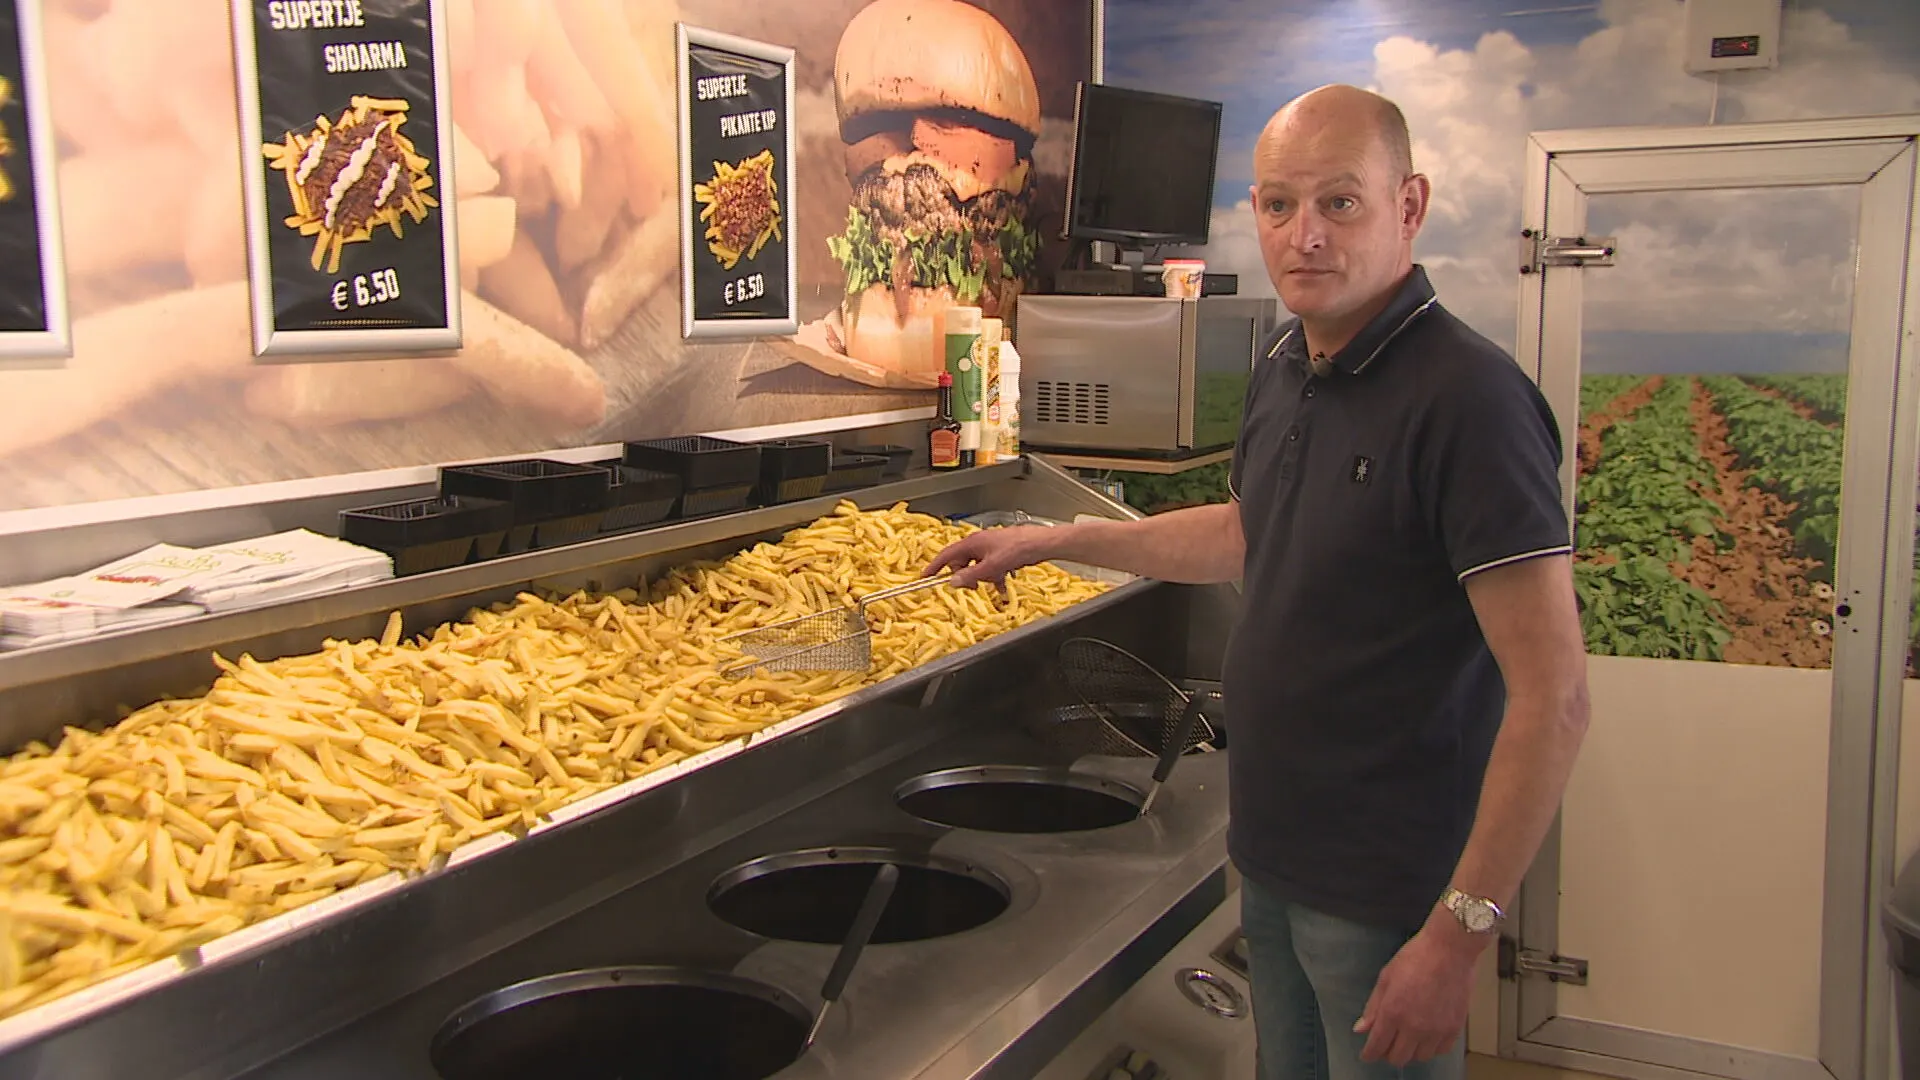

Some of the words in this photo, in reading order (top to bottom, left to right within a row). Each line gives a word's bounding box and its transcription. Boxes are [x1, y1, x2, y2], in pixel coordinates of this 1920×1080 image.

[268, 0, 365, 30] SUPERTJE
[324, 40, 407, 73] SHOARMA
[697, 74, 748, 100] SUPERTJE
[720, 112, 761, 138] PIKANTE
[761, 109, 777, 131] KIP
[331, 281, 349, 310] €
[354, 268, 400, 306] 6.50
[724, 282, 734, 305] €
[737, 273, 764, 302] 6.50
